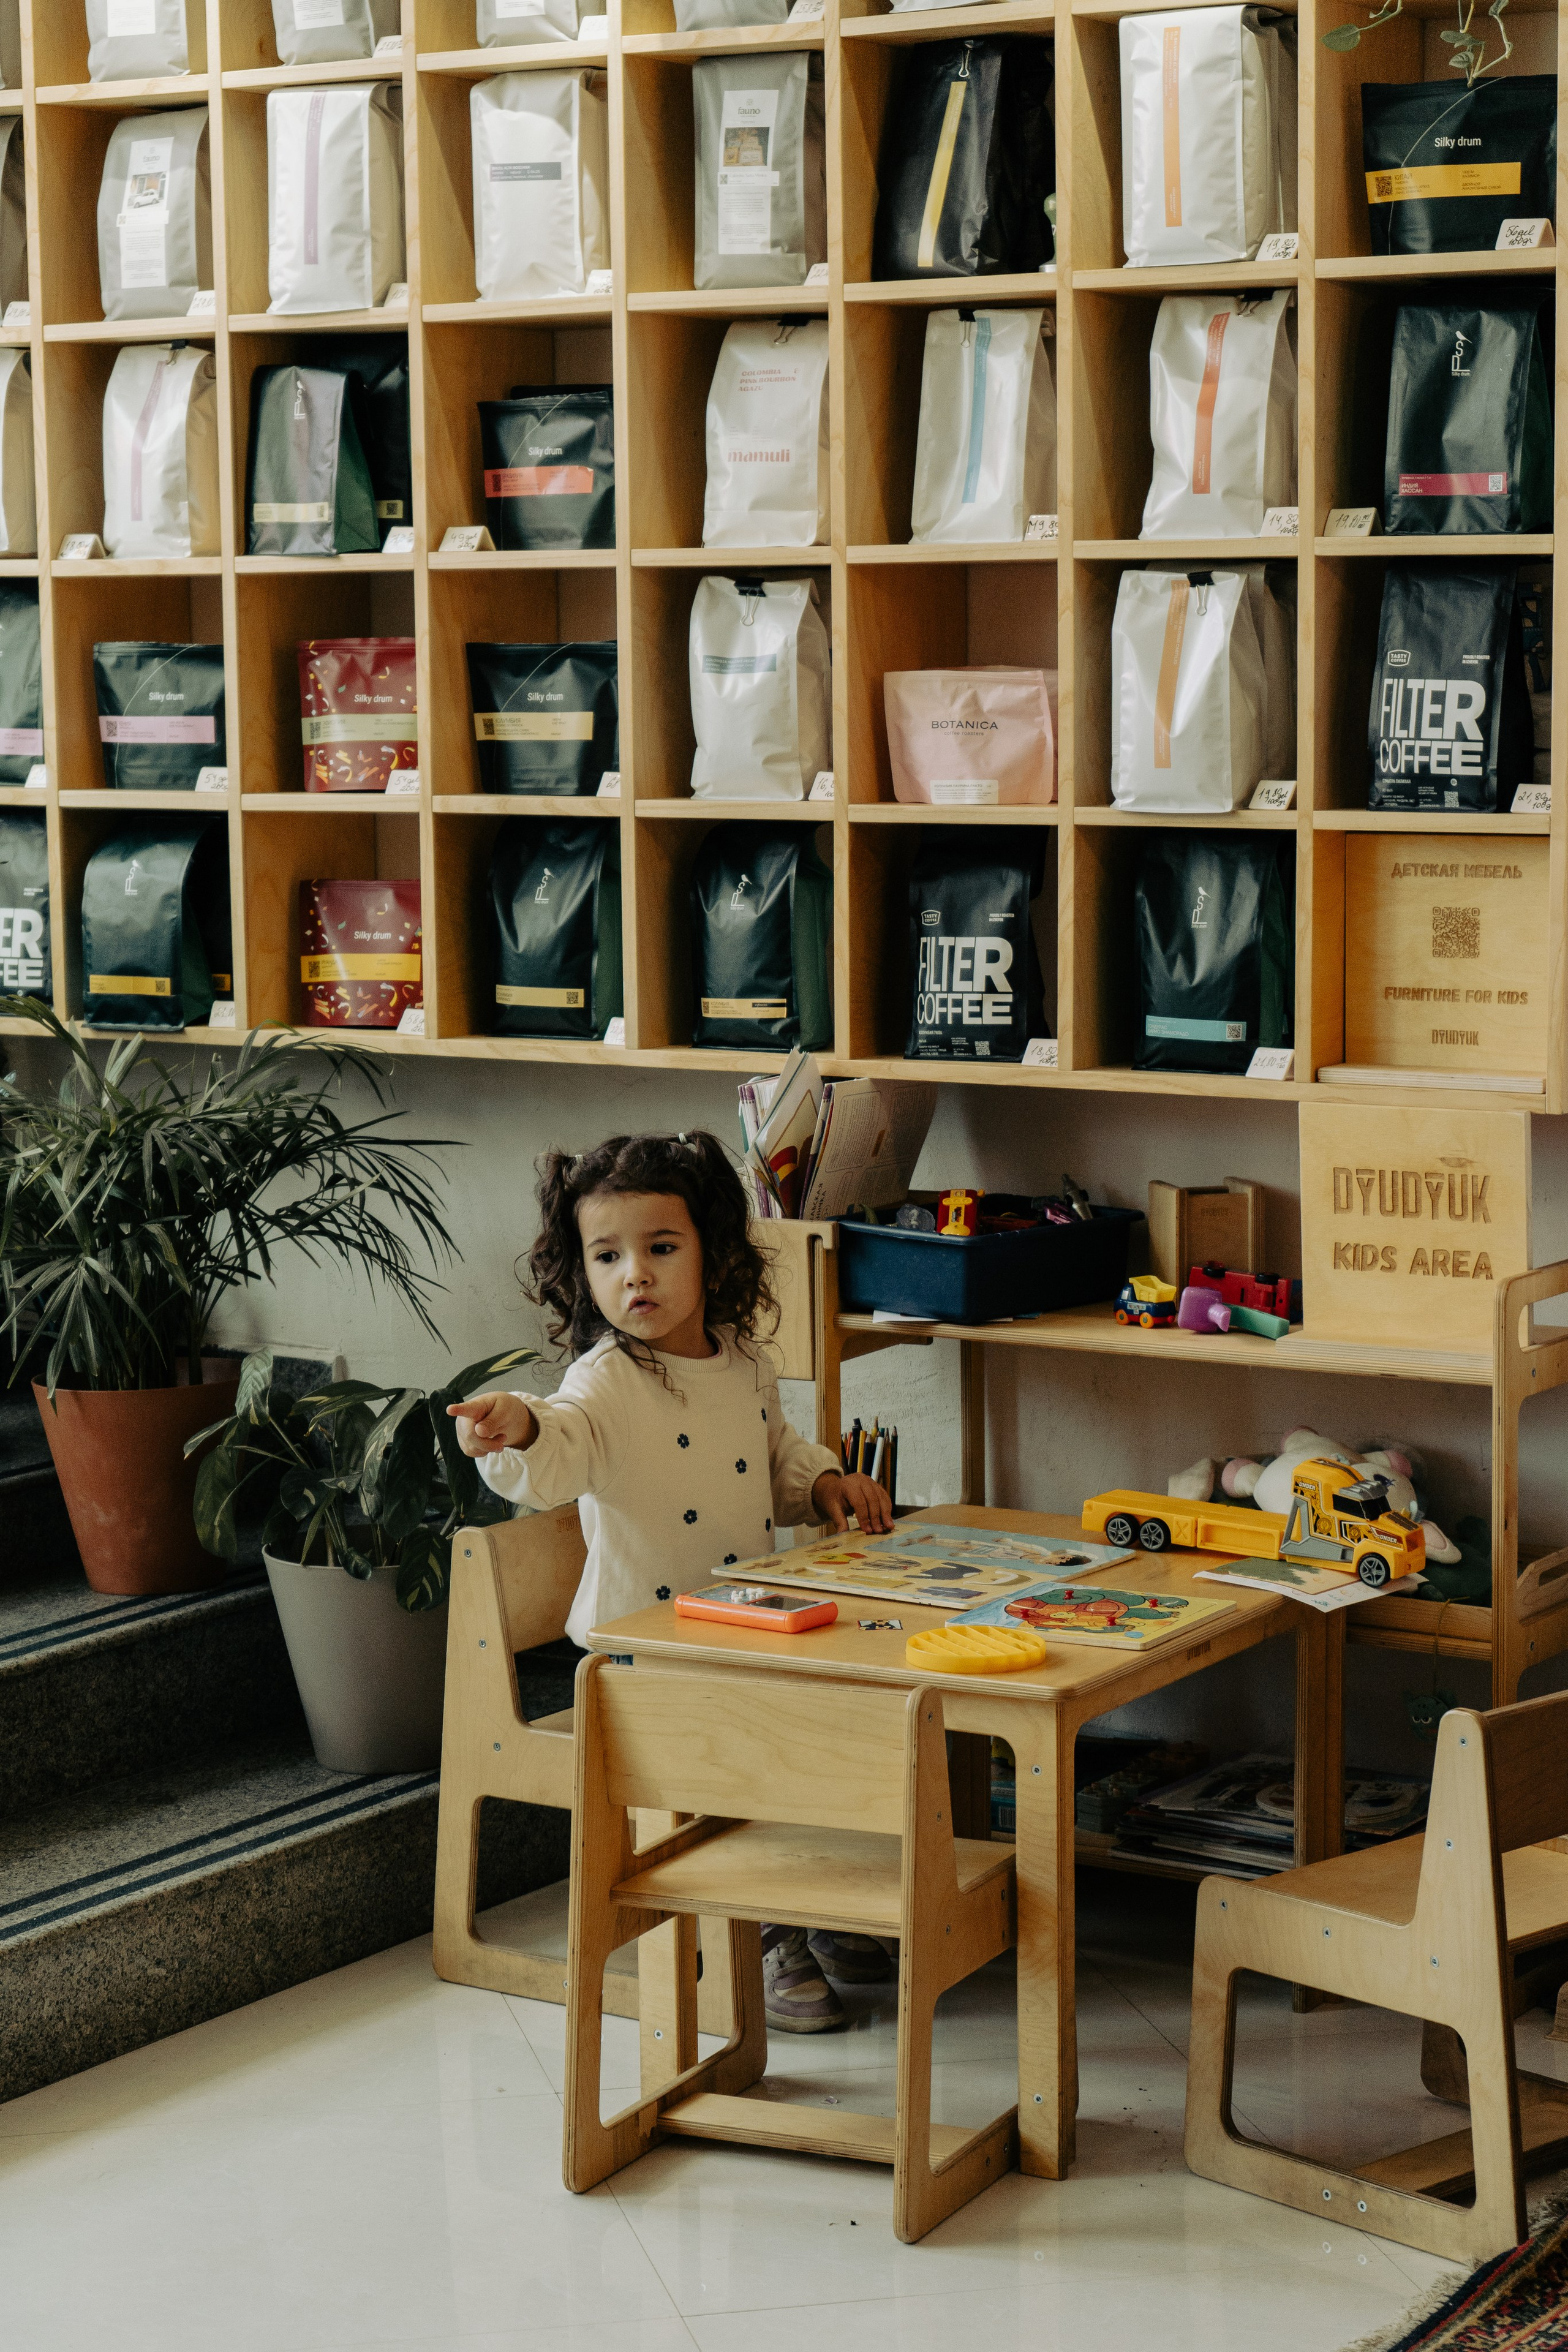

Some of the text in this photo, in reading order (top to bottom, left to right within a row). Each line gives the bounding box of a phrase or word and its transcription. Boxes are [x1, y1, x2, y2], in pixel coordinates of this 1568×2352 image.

[1434, 136, 1482, 149] Silky drum
[529, 447, 562, 458] Silky drum
[727, 448, 790, 462] mamuli
[149, 692, 184, 703] Silky drum
[354, 694, 372, 704] Silky
[527, 692, 564, 703] Silky drum
[1380, 678, 1486, 741] FILTER
[931, 720, 998, 729] BOTANICA
[1379, 739, 1484, 776] COFFEE
[1390, 862, 1523, 879] ДЕТСКАЯ МЕБЕЛЬ
[353, 930, 391, 941] Silky drum
[918, 937, 1014, 992] FILTER
[1384, 986, 1529, 1005] FURNITURE FOR KIDS
[918, 993, 1013, 1025] COFFEE
[1333, 1242, 1494, 1281] KIDS AREA
[1298, 1482, 1316, 1491] UNDER
[1379, 1534, 1398, 1544] UNDER
